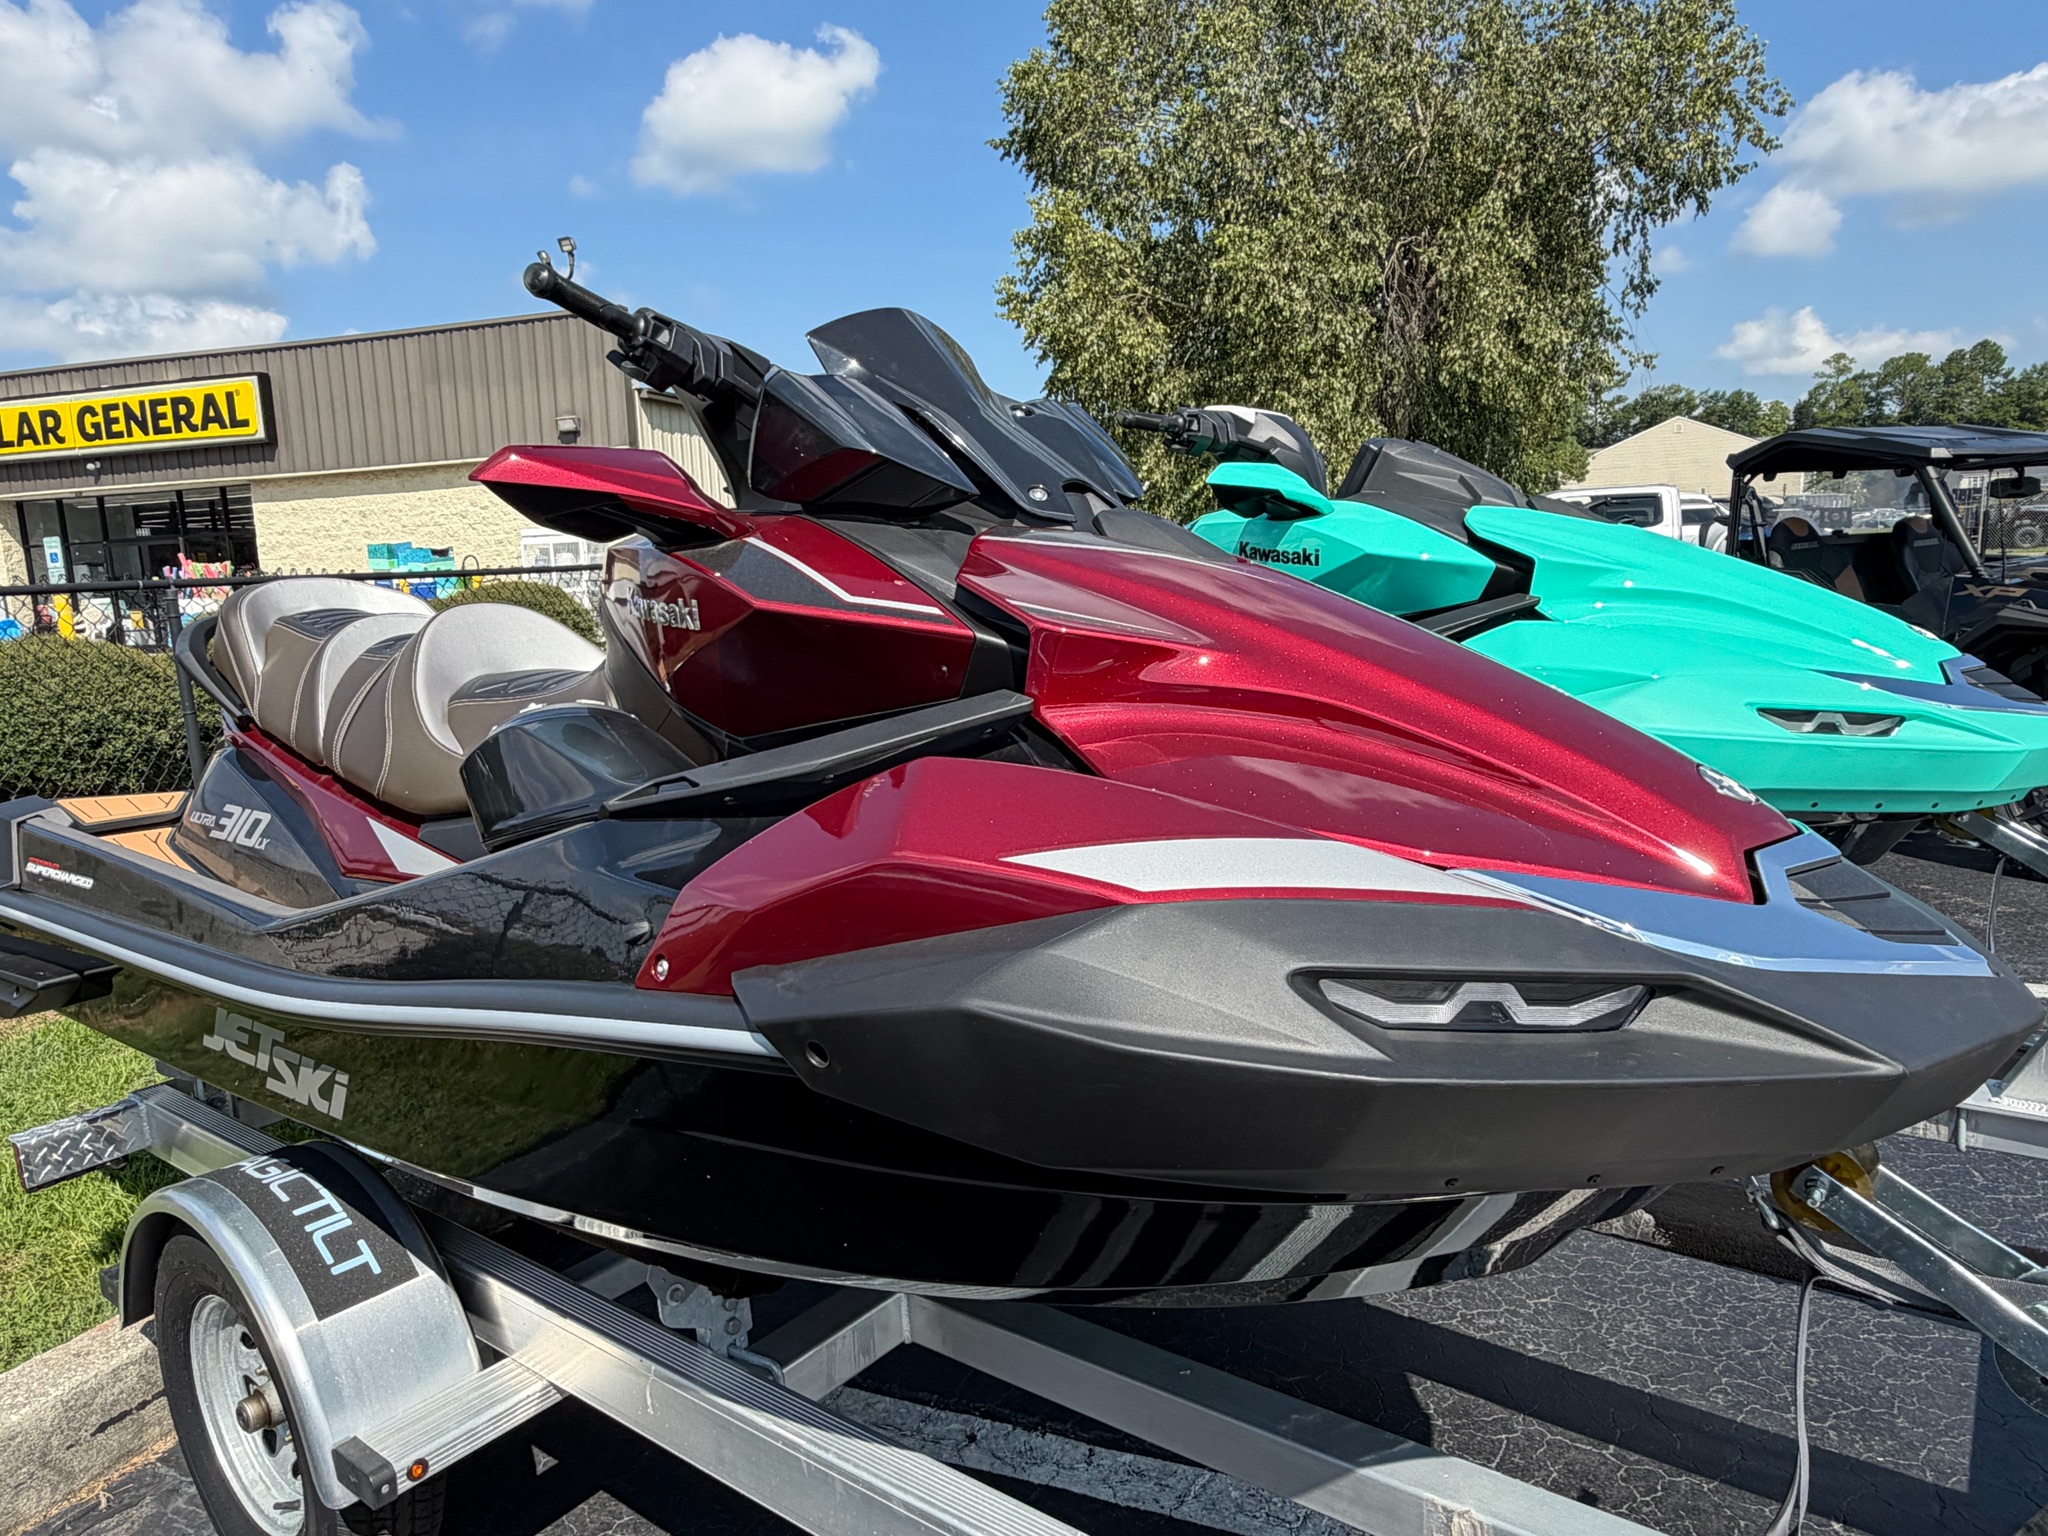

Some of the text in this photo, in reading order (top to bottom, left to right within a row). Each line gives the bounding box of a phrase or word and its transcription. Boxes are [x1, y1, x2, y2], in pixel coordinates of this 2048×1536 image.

[76, 391, 250, 442] GENERAL
[1238, 541, 1320, 567] Kawasaki
[627, 587, 701, 631] Kawasaki
[1953, 584, 2029, 598] XP
[190, 804, 271, 850] ULTRA 310 LX
[202, 1007, 285, 1072] JET
[292, 1188, 382, 1276] TILT
